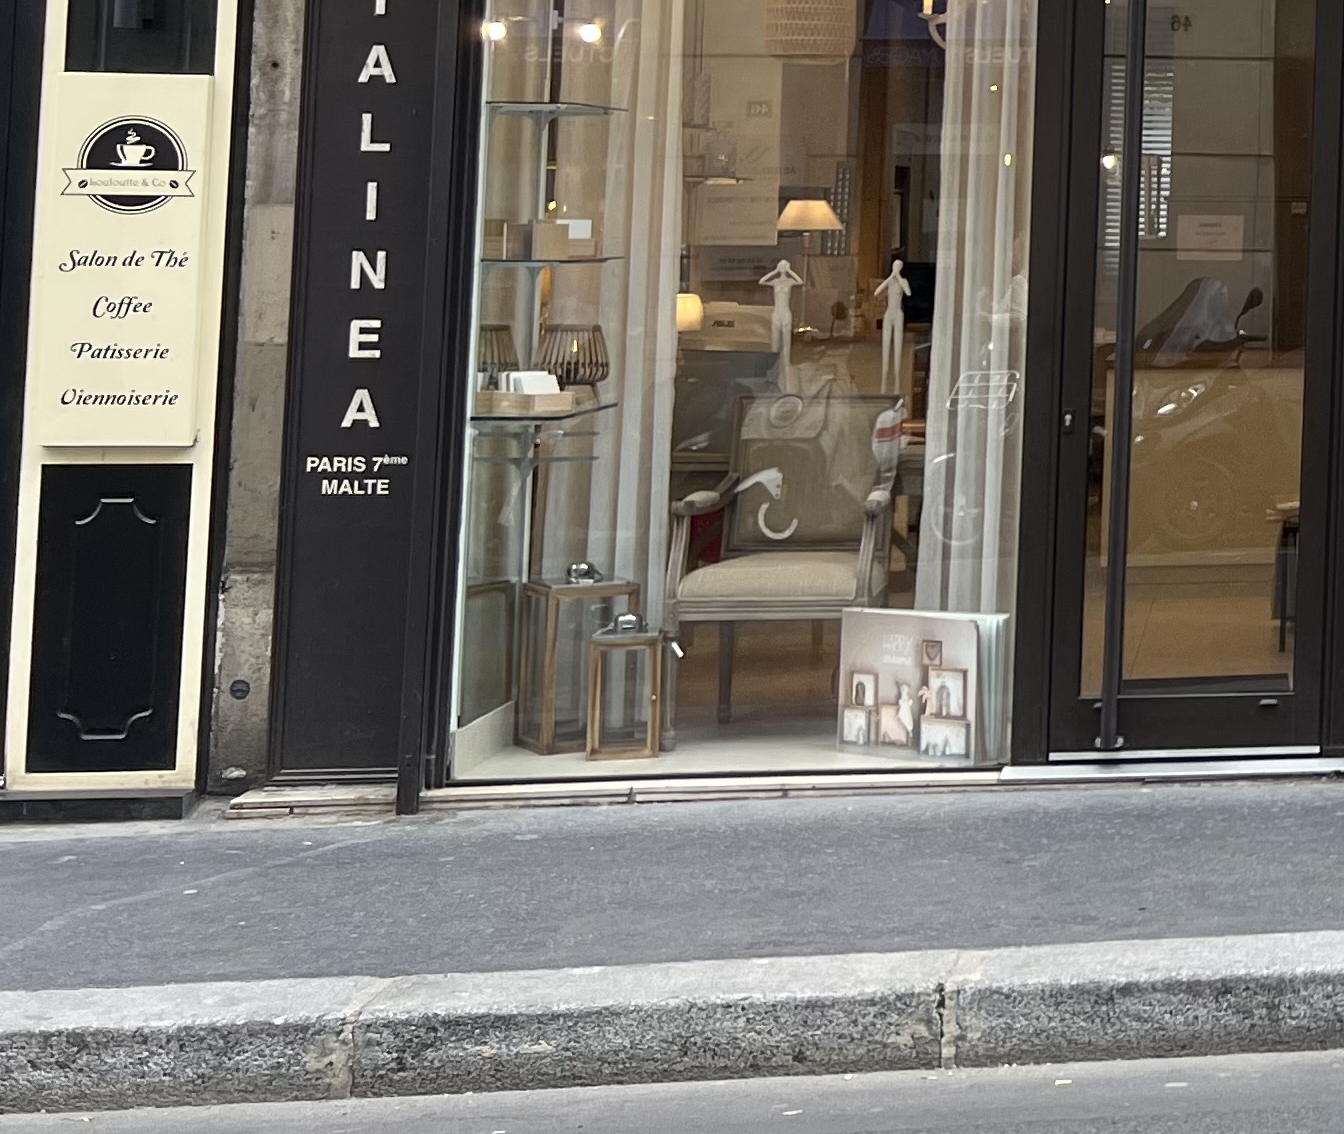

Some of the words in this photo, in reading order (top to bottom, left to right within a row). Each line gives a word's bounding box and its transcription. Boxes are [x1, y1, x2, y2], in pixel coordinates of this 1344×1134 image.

[59, 250, 118, 273] Salon
[122, 250, 144, 268] de
[151, 249, 189, 268] Thé
[92, 296, 153, 320] Coffee
[70, 342, 169, 360] Patisserie
[60, 388, 179, 407] Viennoiserie
[306, 456, 367, 472] PARIS
[371, 452, 409, 472] 7ème
[321, 478, 390, 495] MALTE
